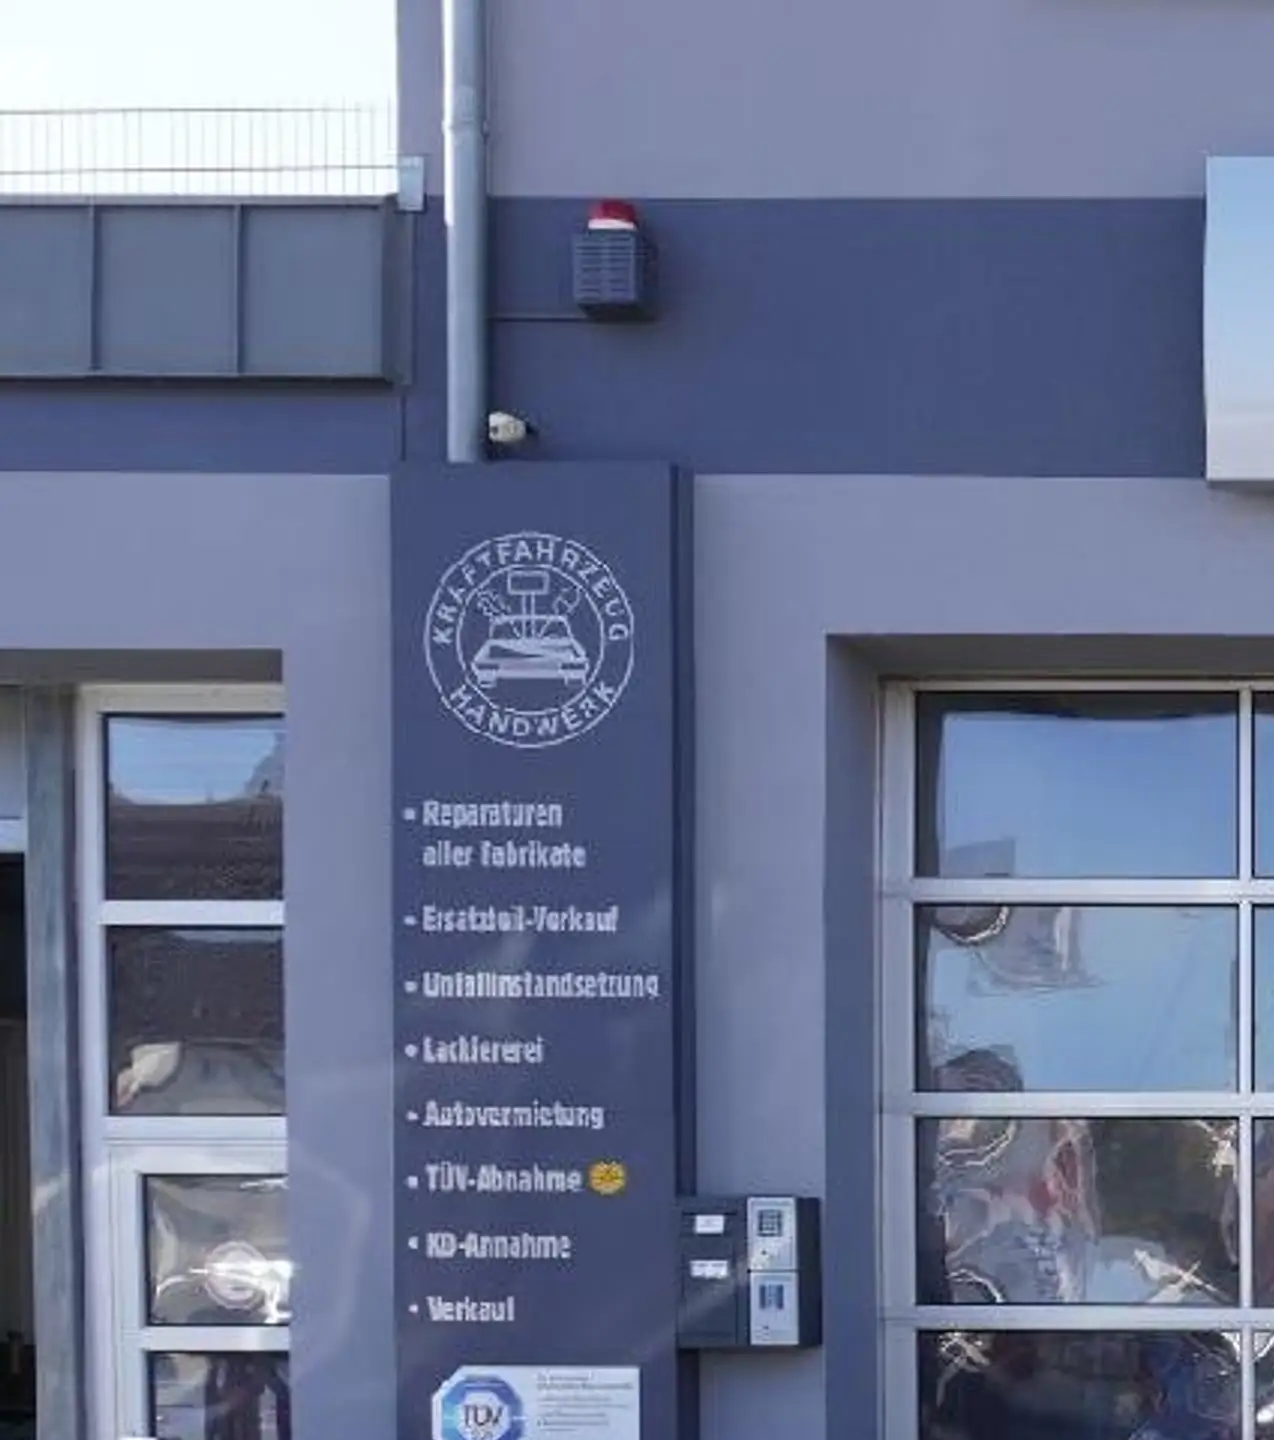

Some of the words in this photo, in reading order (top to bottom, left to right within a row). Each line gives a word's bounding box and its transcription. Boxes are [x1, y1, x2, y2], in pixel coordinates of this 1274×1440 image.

[432, 540, 629, 645] KRAFTFAHRZEUG
[450, 681, 615, 737] HANDWERK
[422, 800, 563, 829] Reparaturen
[422, 839, 474, 868] aller
[422, 970, 661, 999] Unfallinstandsetzung
[422, 1034, 544, 1064] Lackiererei
[422, 1099, 605, 1130] Autovermietung
[425, 1161, 582, 1192] TÜV-Abnahme
[426, 1295, 516, 1322] Verkauf
